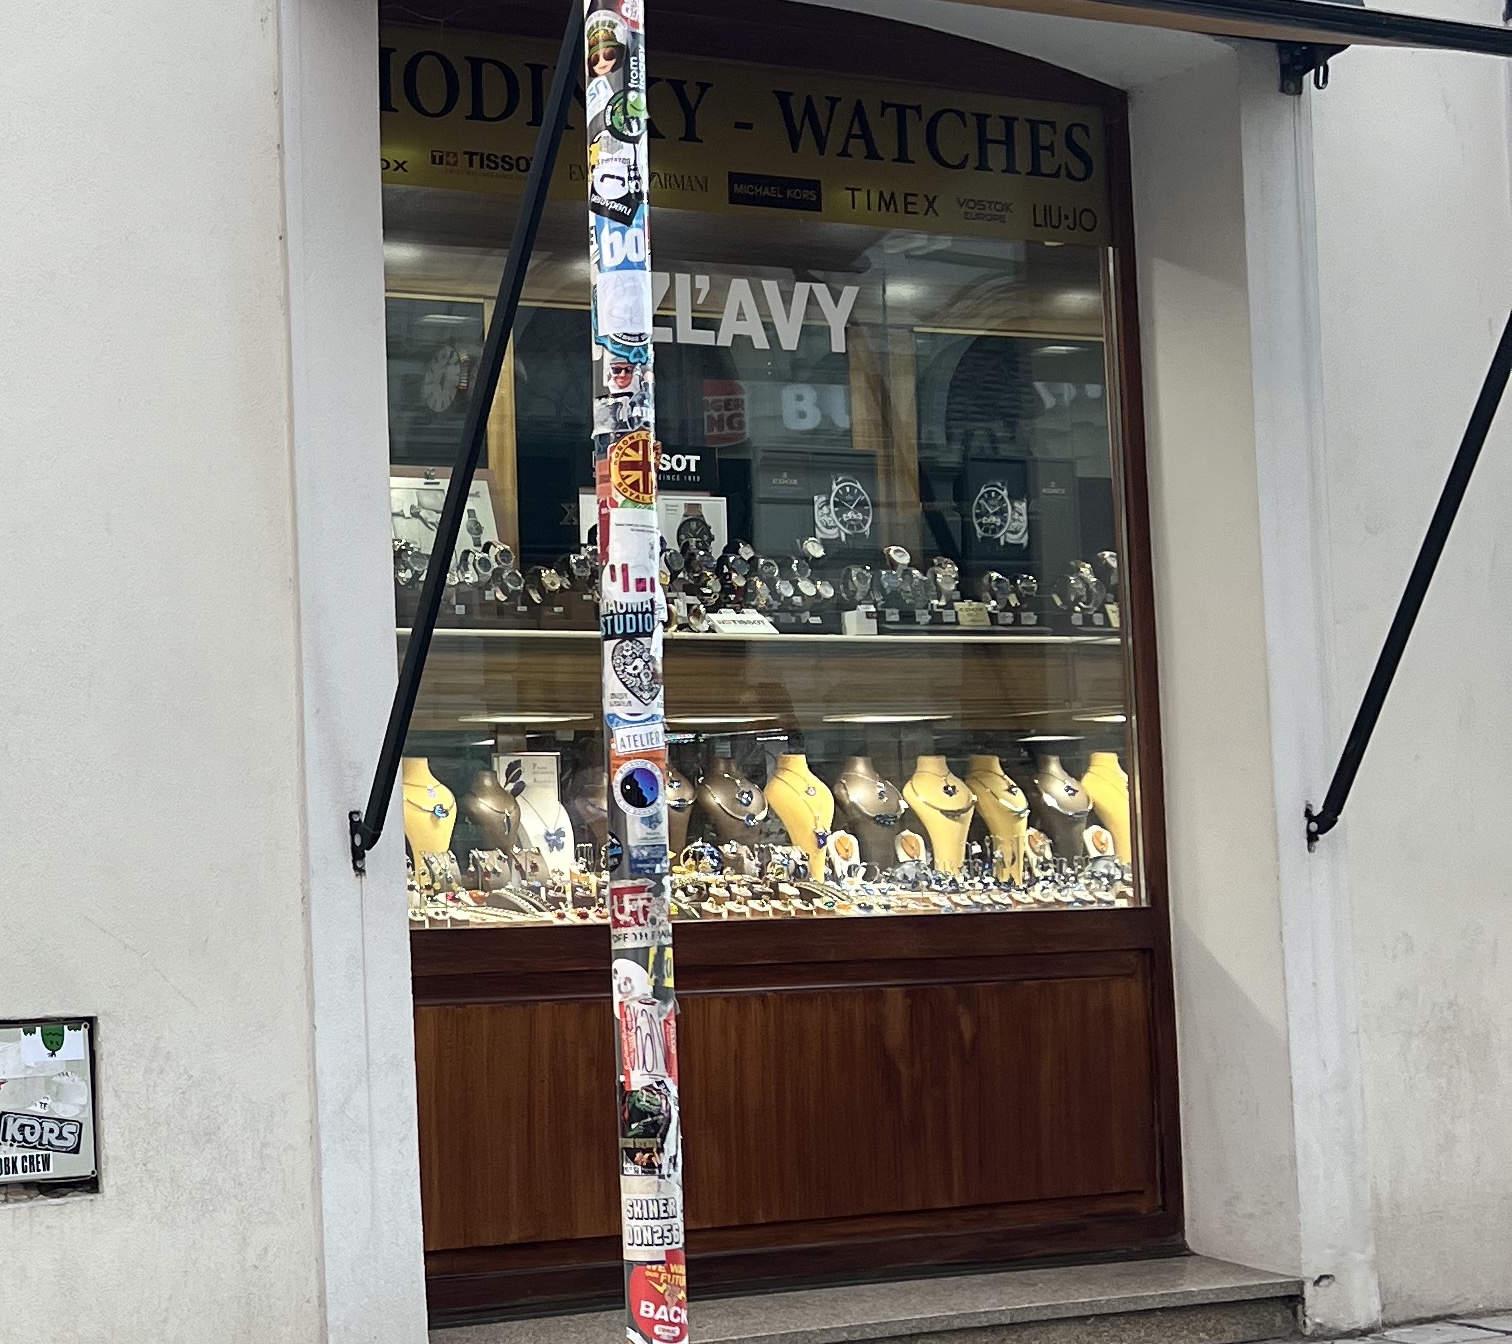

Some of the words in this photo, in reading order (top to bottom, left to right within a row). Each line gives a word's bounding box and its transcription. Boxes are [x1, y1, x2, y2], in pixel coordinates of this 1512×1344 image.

[772, 89, 1094, 183] WATCHES
[462, 150, 534, 173] TISSO
[733, 182, 784, 199] MICHAEL
[786, 184, 818, 202] KORS
[844, 186, 940, 218] TIMEX
[956, 197, 1014, 214] VOSTOK
[963, 211, 1007, 224] EUROPE
[600, 613, 654, 637] STUDIO
[619, 731, 661, 750] ATELIER
[21, 1152, 51, 1174] CREW
[638, 1299, 688, 1326] BACK
